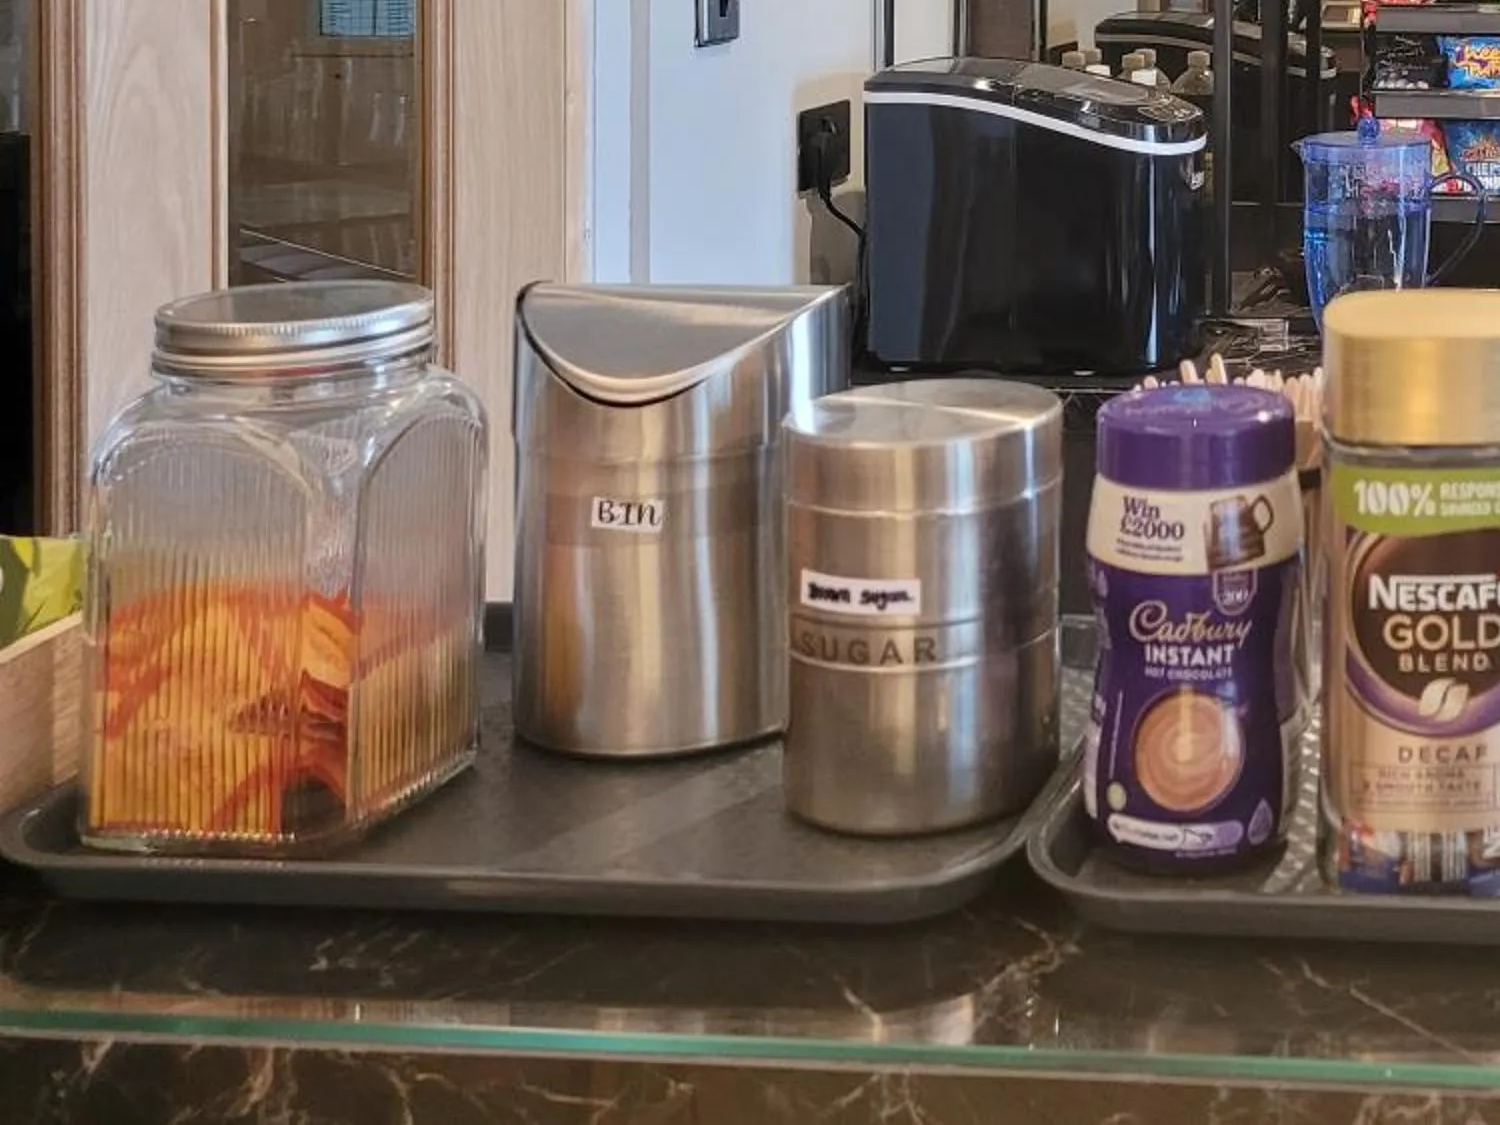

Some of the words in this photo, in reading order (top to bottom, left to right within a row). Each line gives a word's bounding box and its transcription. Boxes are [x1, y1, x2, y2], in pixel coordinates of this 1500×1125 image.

[1122, 495, 1161, 521] Win
[1353, 478, 1437, 518] 100%
[1119, 516, 1185, 541] £2000
[1128, 599, 1253, 650] Cadbury
[800, 630, 938, 666] SUGAR
[1143, 642, 1236, 667] INSTANT
[1398, 652, 1490, 673] BLEND
[1397, 744, 1488, 765] DECAF
